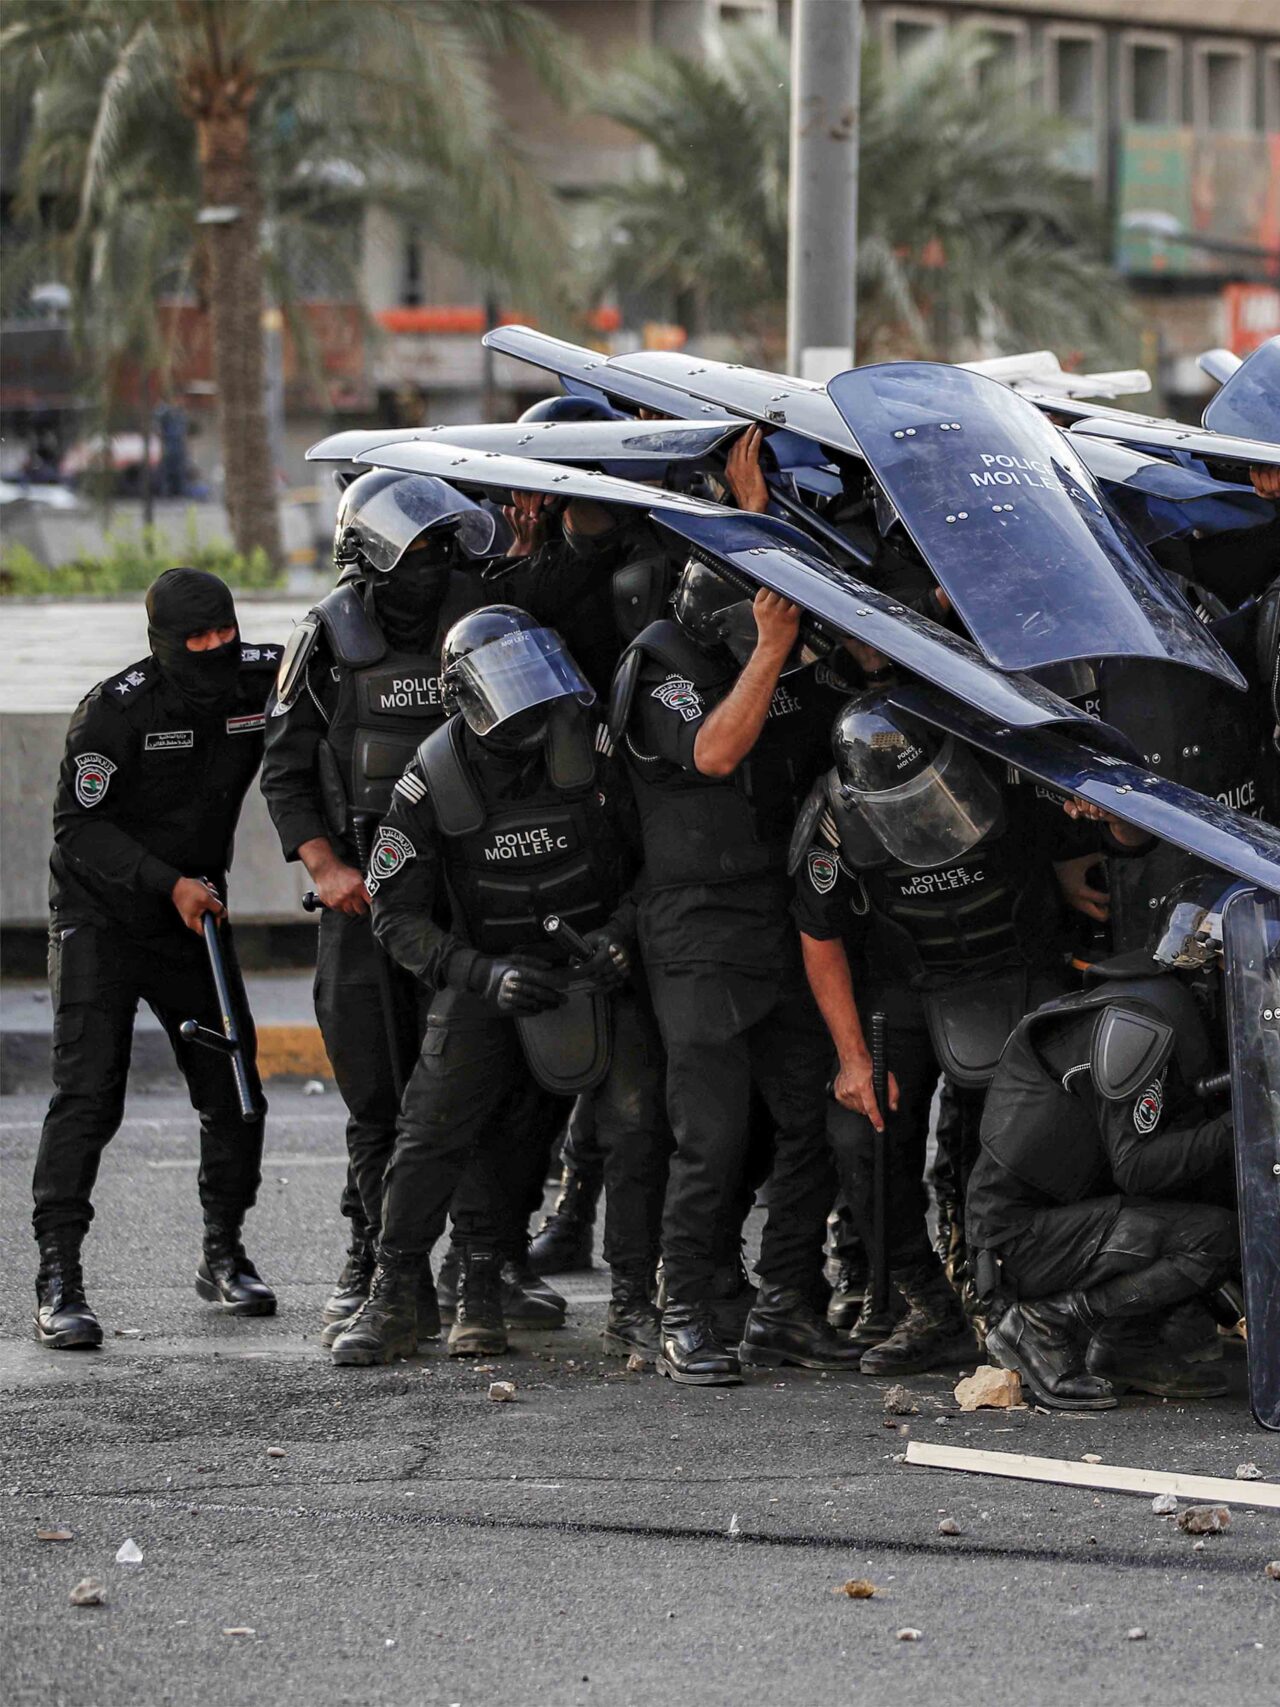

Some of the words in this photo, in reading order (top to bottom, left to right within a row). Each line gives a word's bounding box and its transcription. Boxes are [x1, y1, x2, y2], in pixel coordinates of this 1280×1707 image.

[979, 454, 1057, 478] POLICE
[969, 472, 1021, 487] MOI
[380, 693, 413, 708] MOI
[417, 691, 441, 705] L.E.
[495, 827, 550, 848] POLICE
[484, 846, 518, 860] MOI
[900, 882, 934, 896] MOI
[938, 871, 985, 891] L.E.F.C
[911, 867, 966, 886] POLICE
